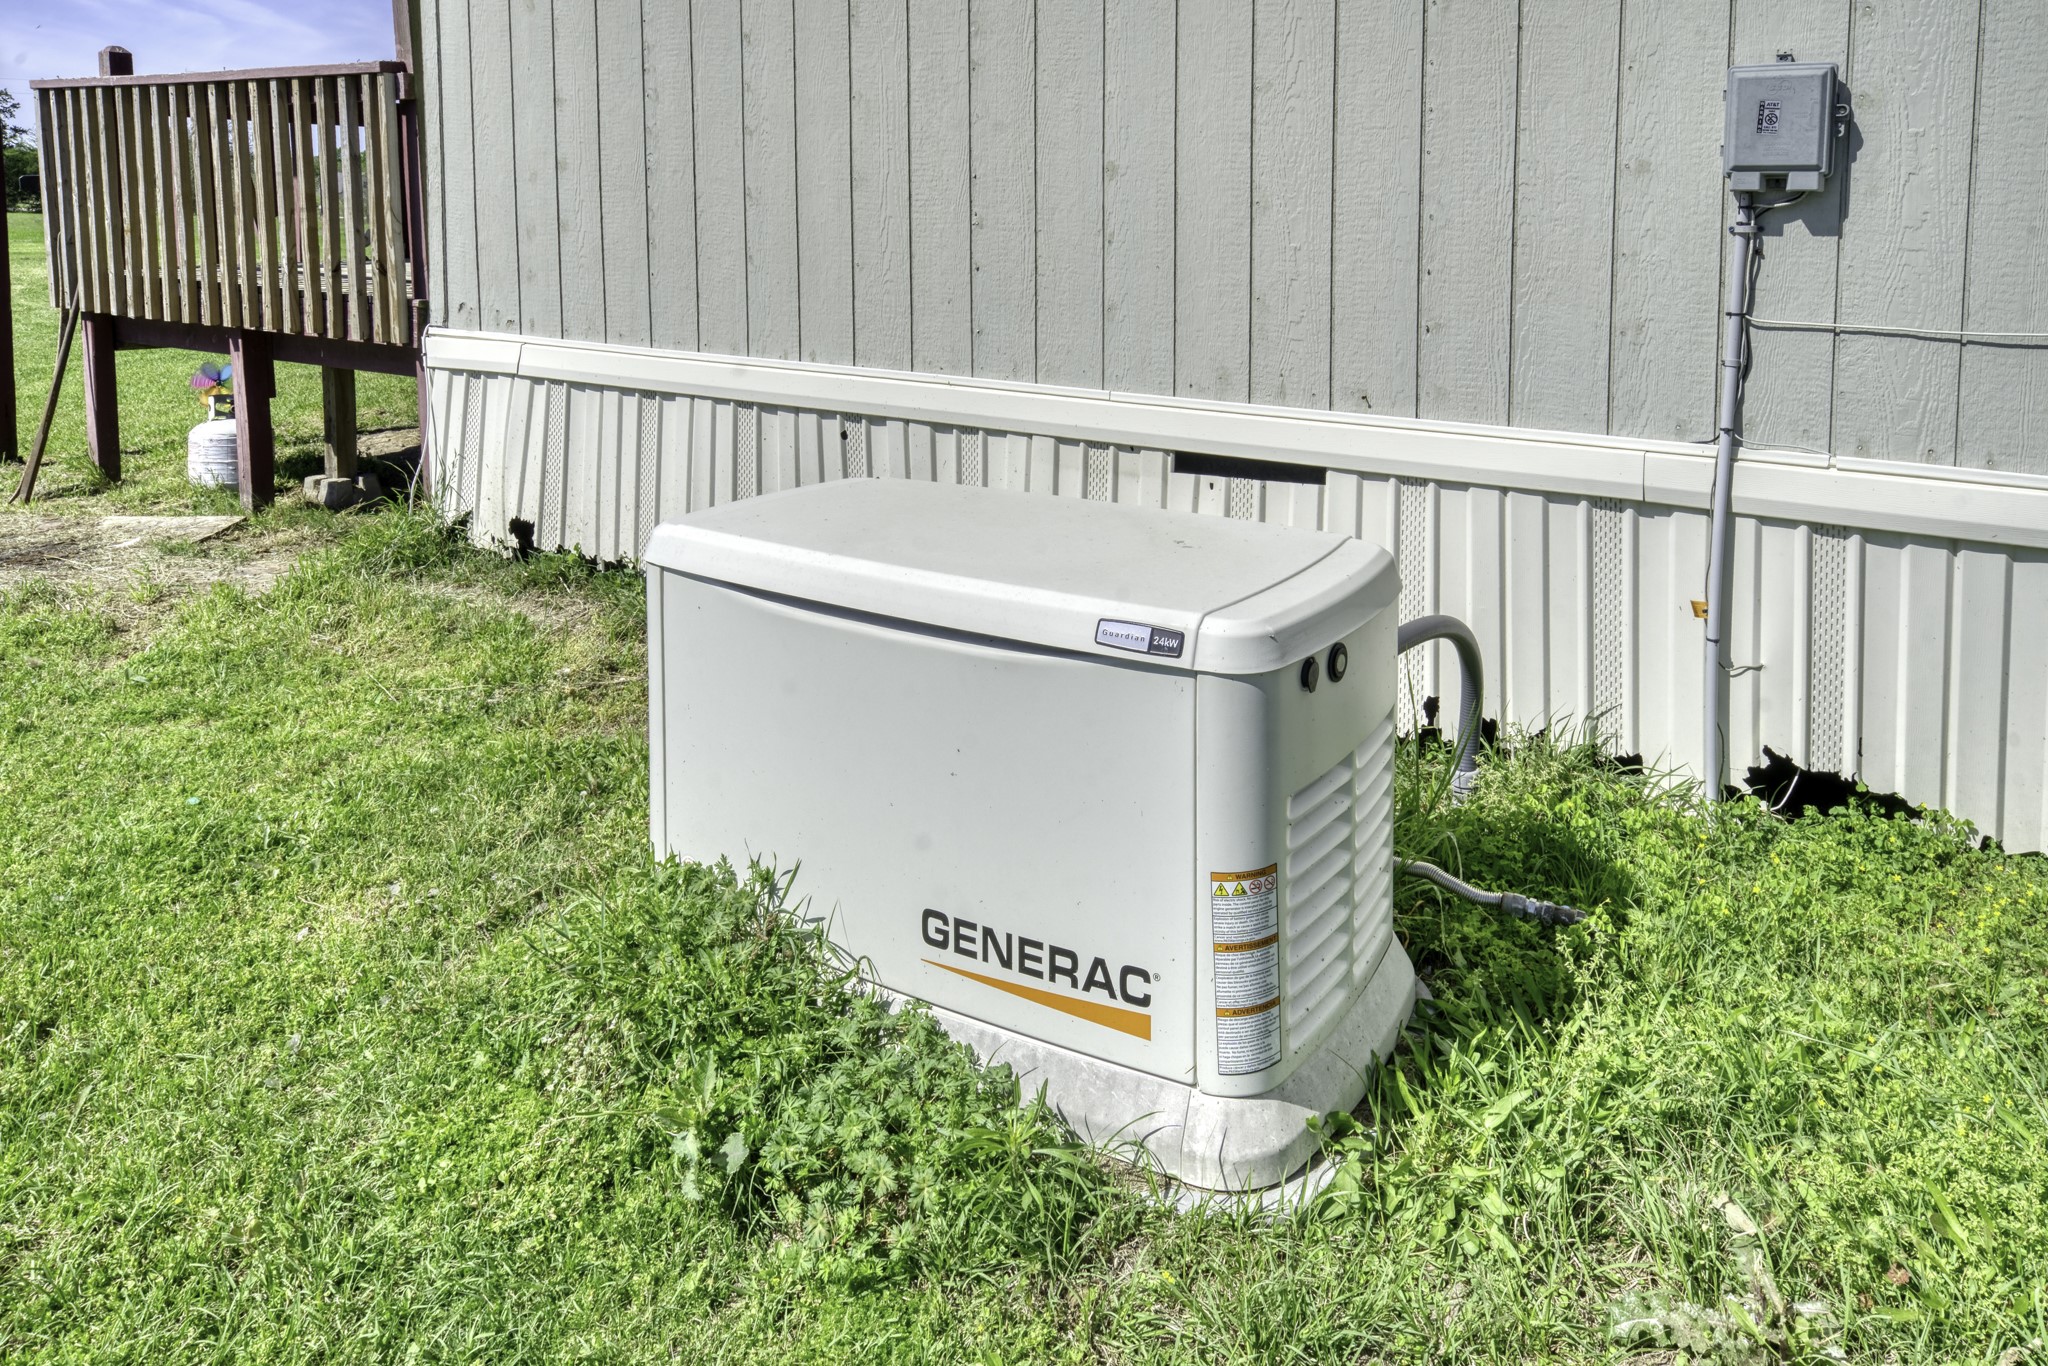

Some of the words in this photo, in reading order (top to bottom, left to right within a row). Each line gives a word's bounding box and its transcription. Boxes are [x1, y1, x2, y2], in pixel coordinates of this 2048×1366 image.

[1102, 628, 1145, 642] Guardian
[1153, 636, 1179, 648] 24kW
[1235, 870, 1266, 879] WARNING
